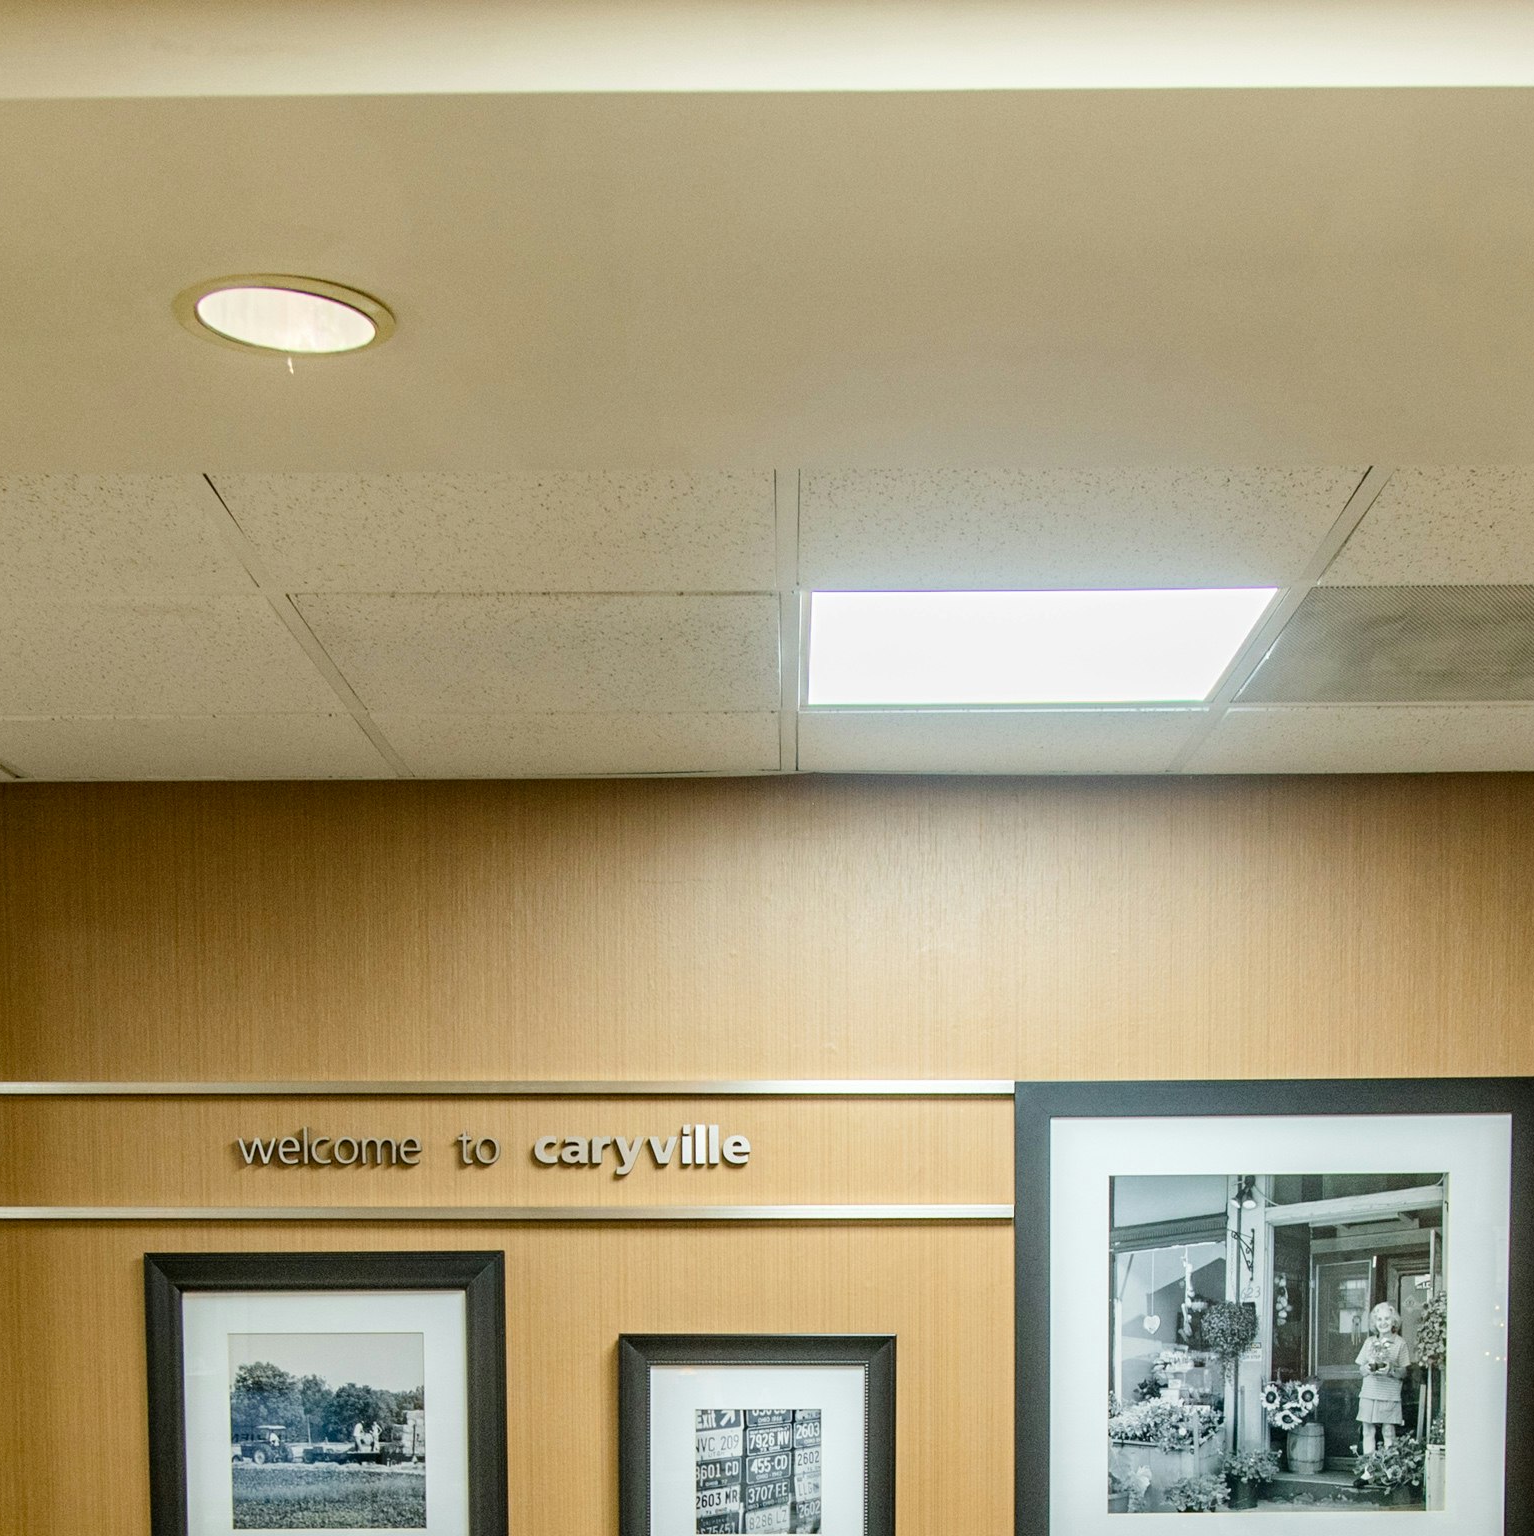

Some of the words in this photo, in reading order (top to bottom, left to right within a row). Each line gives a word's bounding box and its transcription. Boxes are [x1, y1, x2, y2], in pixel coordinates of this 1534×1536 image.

[237, 1127, 421, 1166] welcome
[457, 1130, 501, 1165] to
[534, 1124, 751, 1175] caryville
[721, 1434, 739, 1451] 209
[750, 1433, 774, 1450] 7926
[797, 1451, 819, 1466] 2602
[725, 1461, 739, 1476] CD
[696, 1492, 721, 1510] 2603
[749, 1485, 773, 1503] 3707
